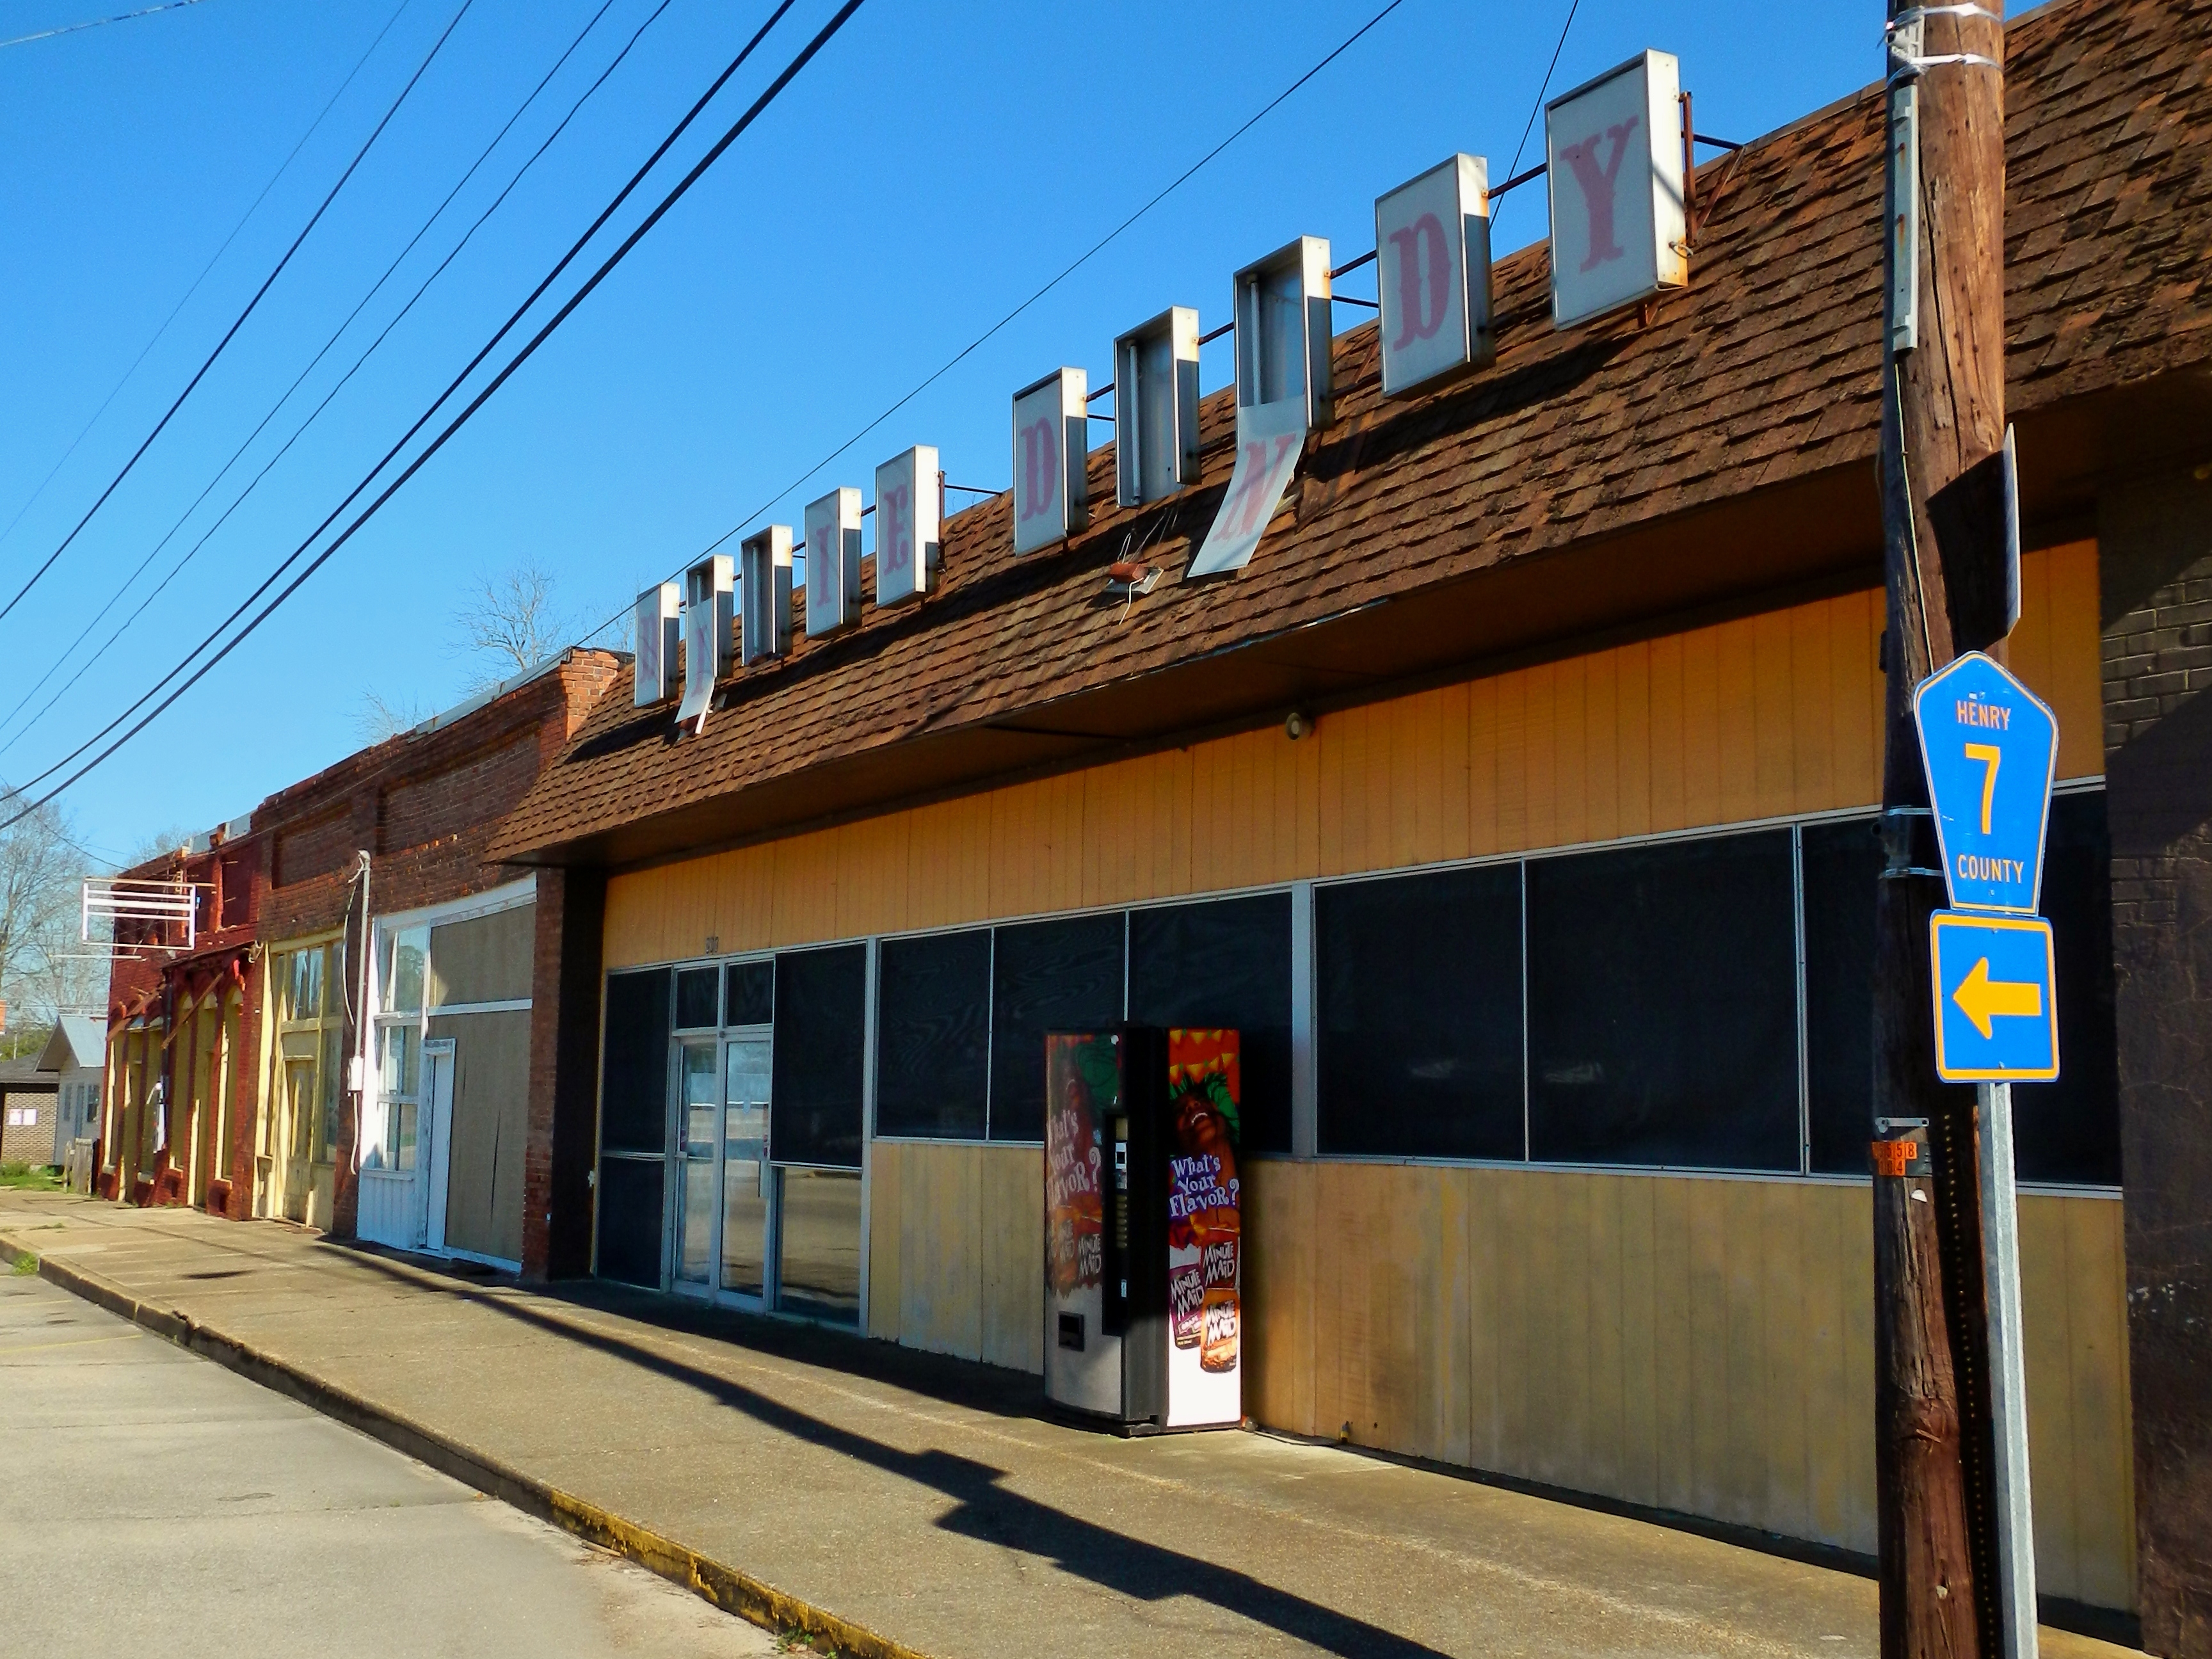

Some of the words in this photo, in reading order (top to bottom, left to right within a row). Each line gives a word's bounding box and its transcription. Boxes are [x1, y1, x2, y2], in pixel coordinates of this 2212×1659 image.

[1957, 700, 2011, 730] HENRY
[1965, 743, 2001, 835] 7
[1957, 854, 2024, 884] COUNTY
[1171, 1154, 1221, 1178] What's
[1177, 1173, 1216, 1196] Your
[1203, 1241, 1234, 1269] MINUTE
[1170, 1269, 1201, 1304] MINUTE
[1205, 1300, 1235, 1327] MINUTE
